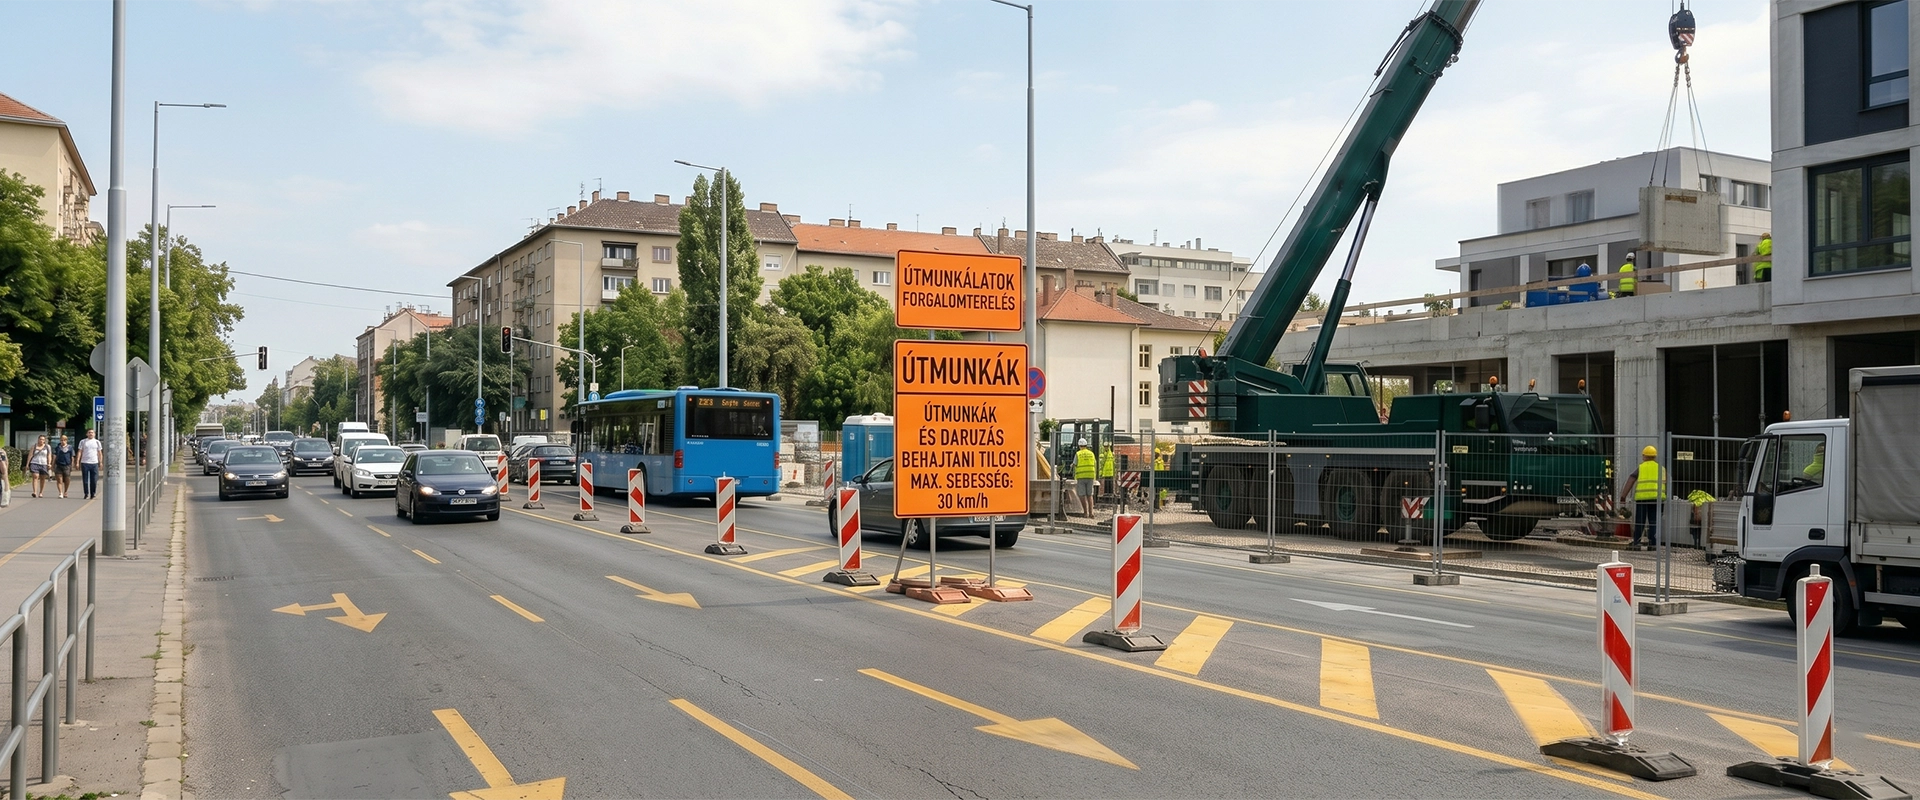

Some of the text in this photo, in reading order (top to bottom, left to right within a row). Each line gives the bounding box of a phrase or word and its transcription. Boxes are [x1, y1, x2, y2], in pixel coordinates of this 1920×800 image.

[904, 263, 1015, 291] ÚTMUNKÁLATOK
[903, 291, 1015, 310] FORGALOMTERELÉS
[902, 350, 1021, 386] ÚTMUNKÁK
[924, 400, 997, 423] ÚTMUNKÁK
[920, 425, 1004, 446] ÉS DARUZÁS
[902, 450, 1021, 468] BEHAJTANI TILOS!
[911, 469, 1013, 490] MAX. SEBESSÉG:
[938, 492, 988, 510] 30 km/h
